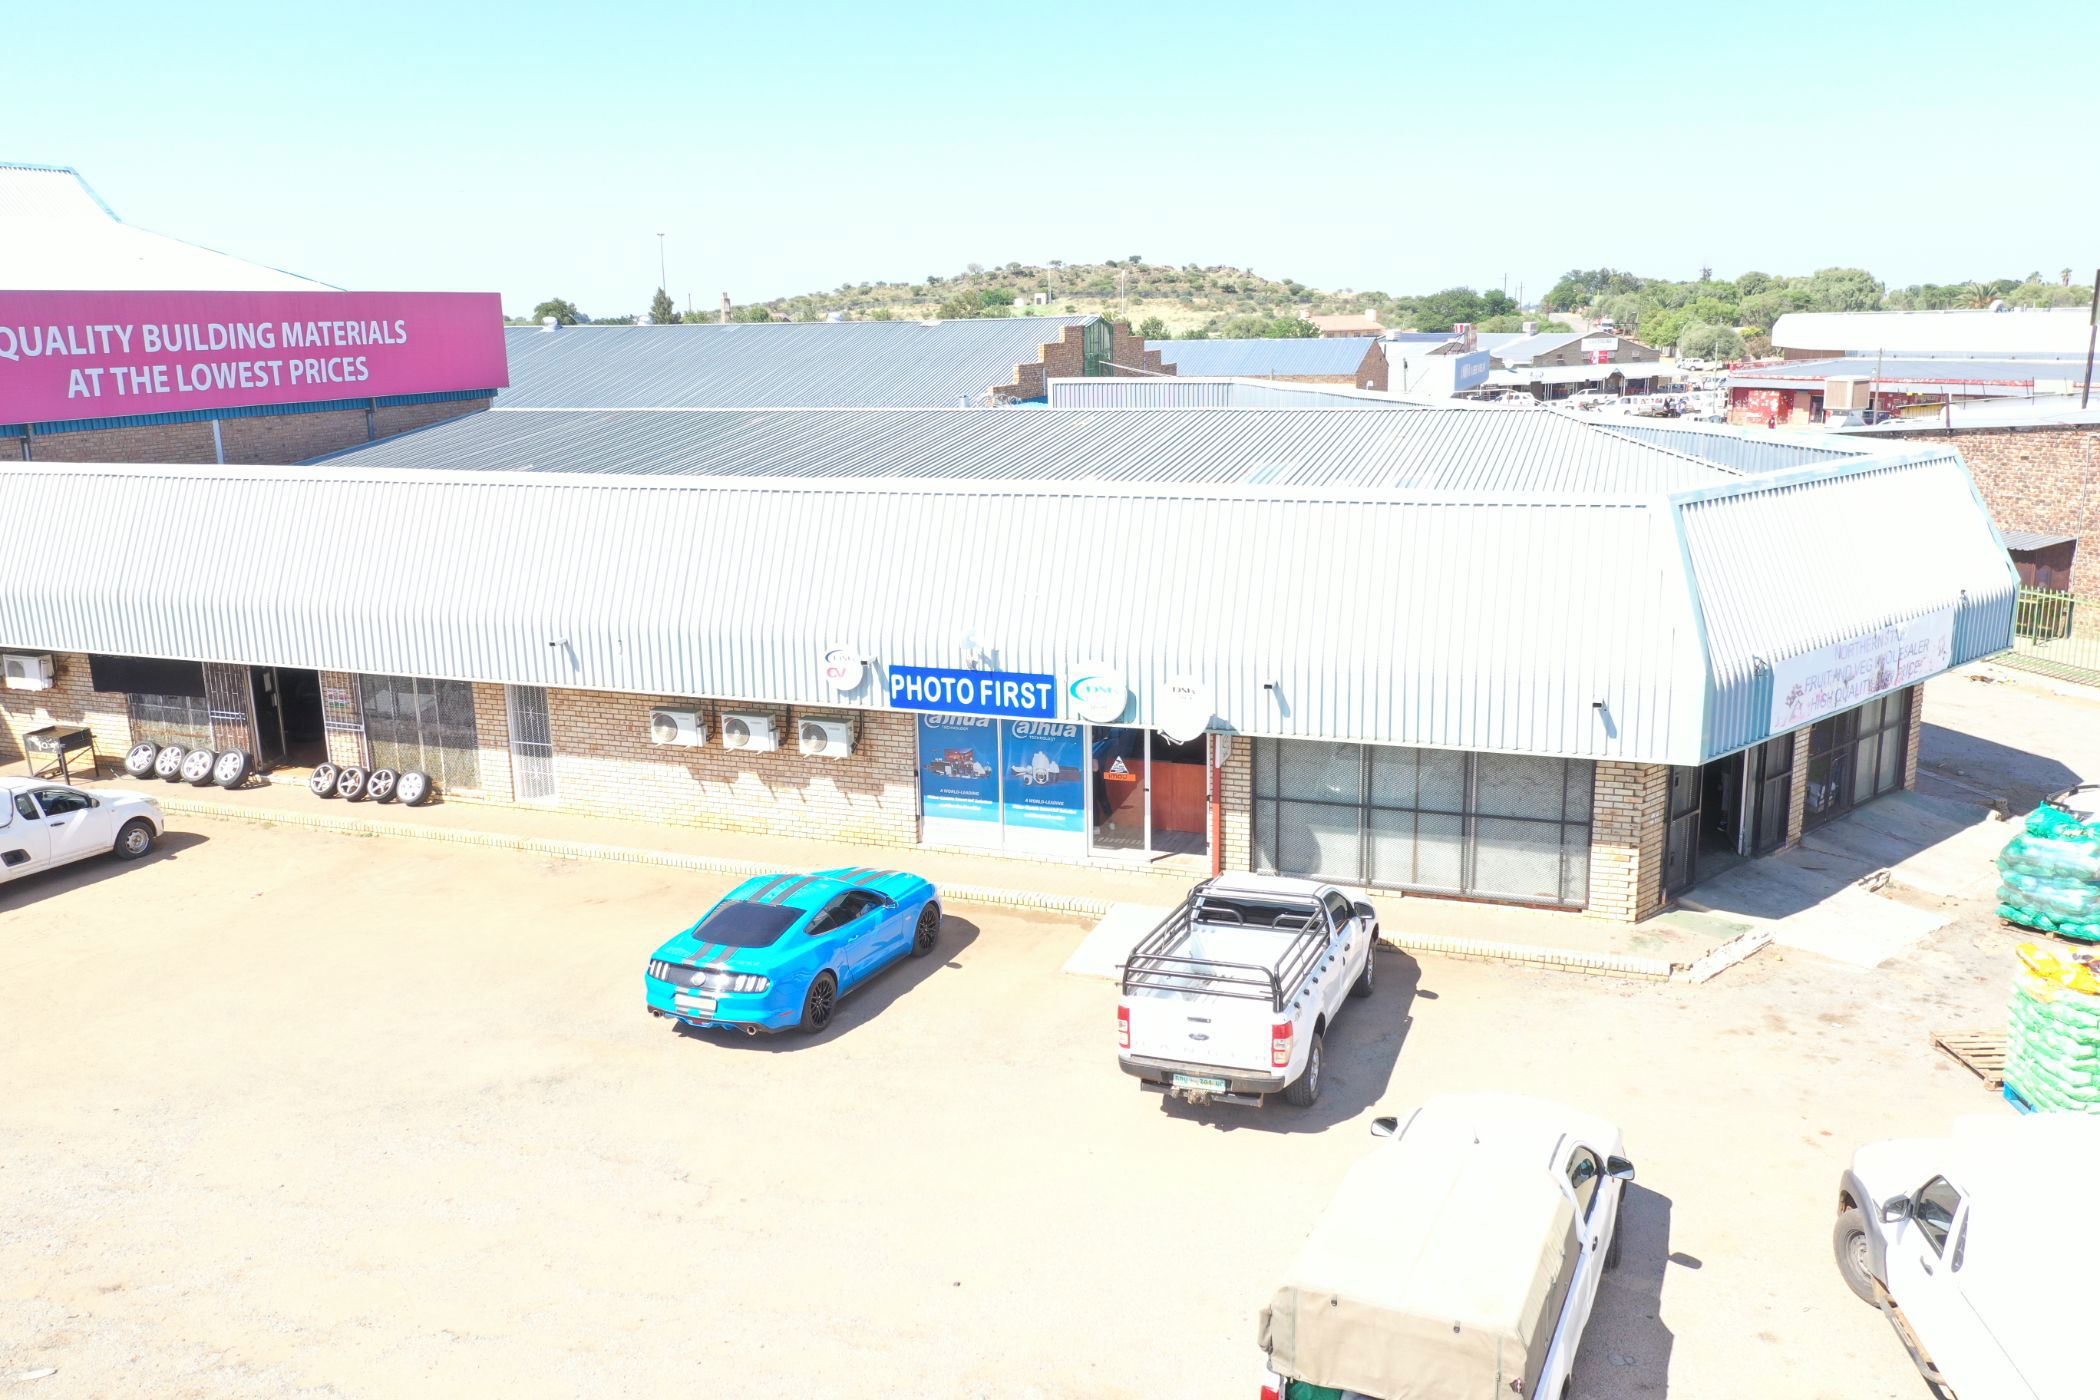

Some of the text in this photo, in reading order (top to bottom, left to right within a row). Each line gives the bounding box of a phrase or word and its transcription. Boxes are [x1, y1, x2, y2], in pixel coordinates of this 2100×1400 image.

[0, 319, 407, 361] QUALITY BUILDING MATERIALS
[68, 356, 369, 398] AT THE LOWEST PRICES
[891, 674, 1052, 710] PHOTO FIRST
[1804, 668, 1832, 691] FRUIT
[1855, 659, 1873, 676] VEG
